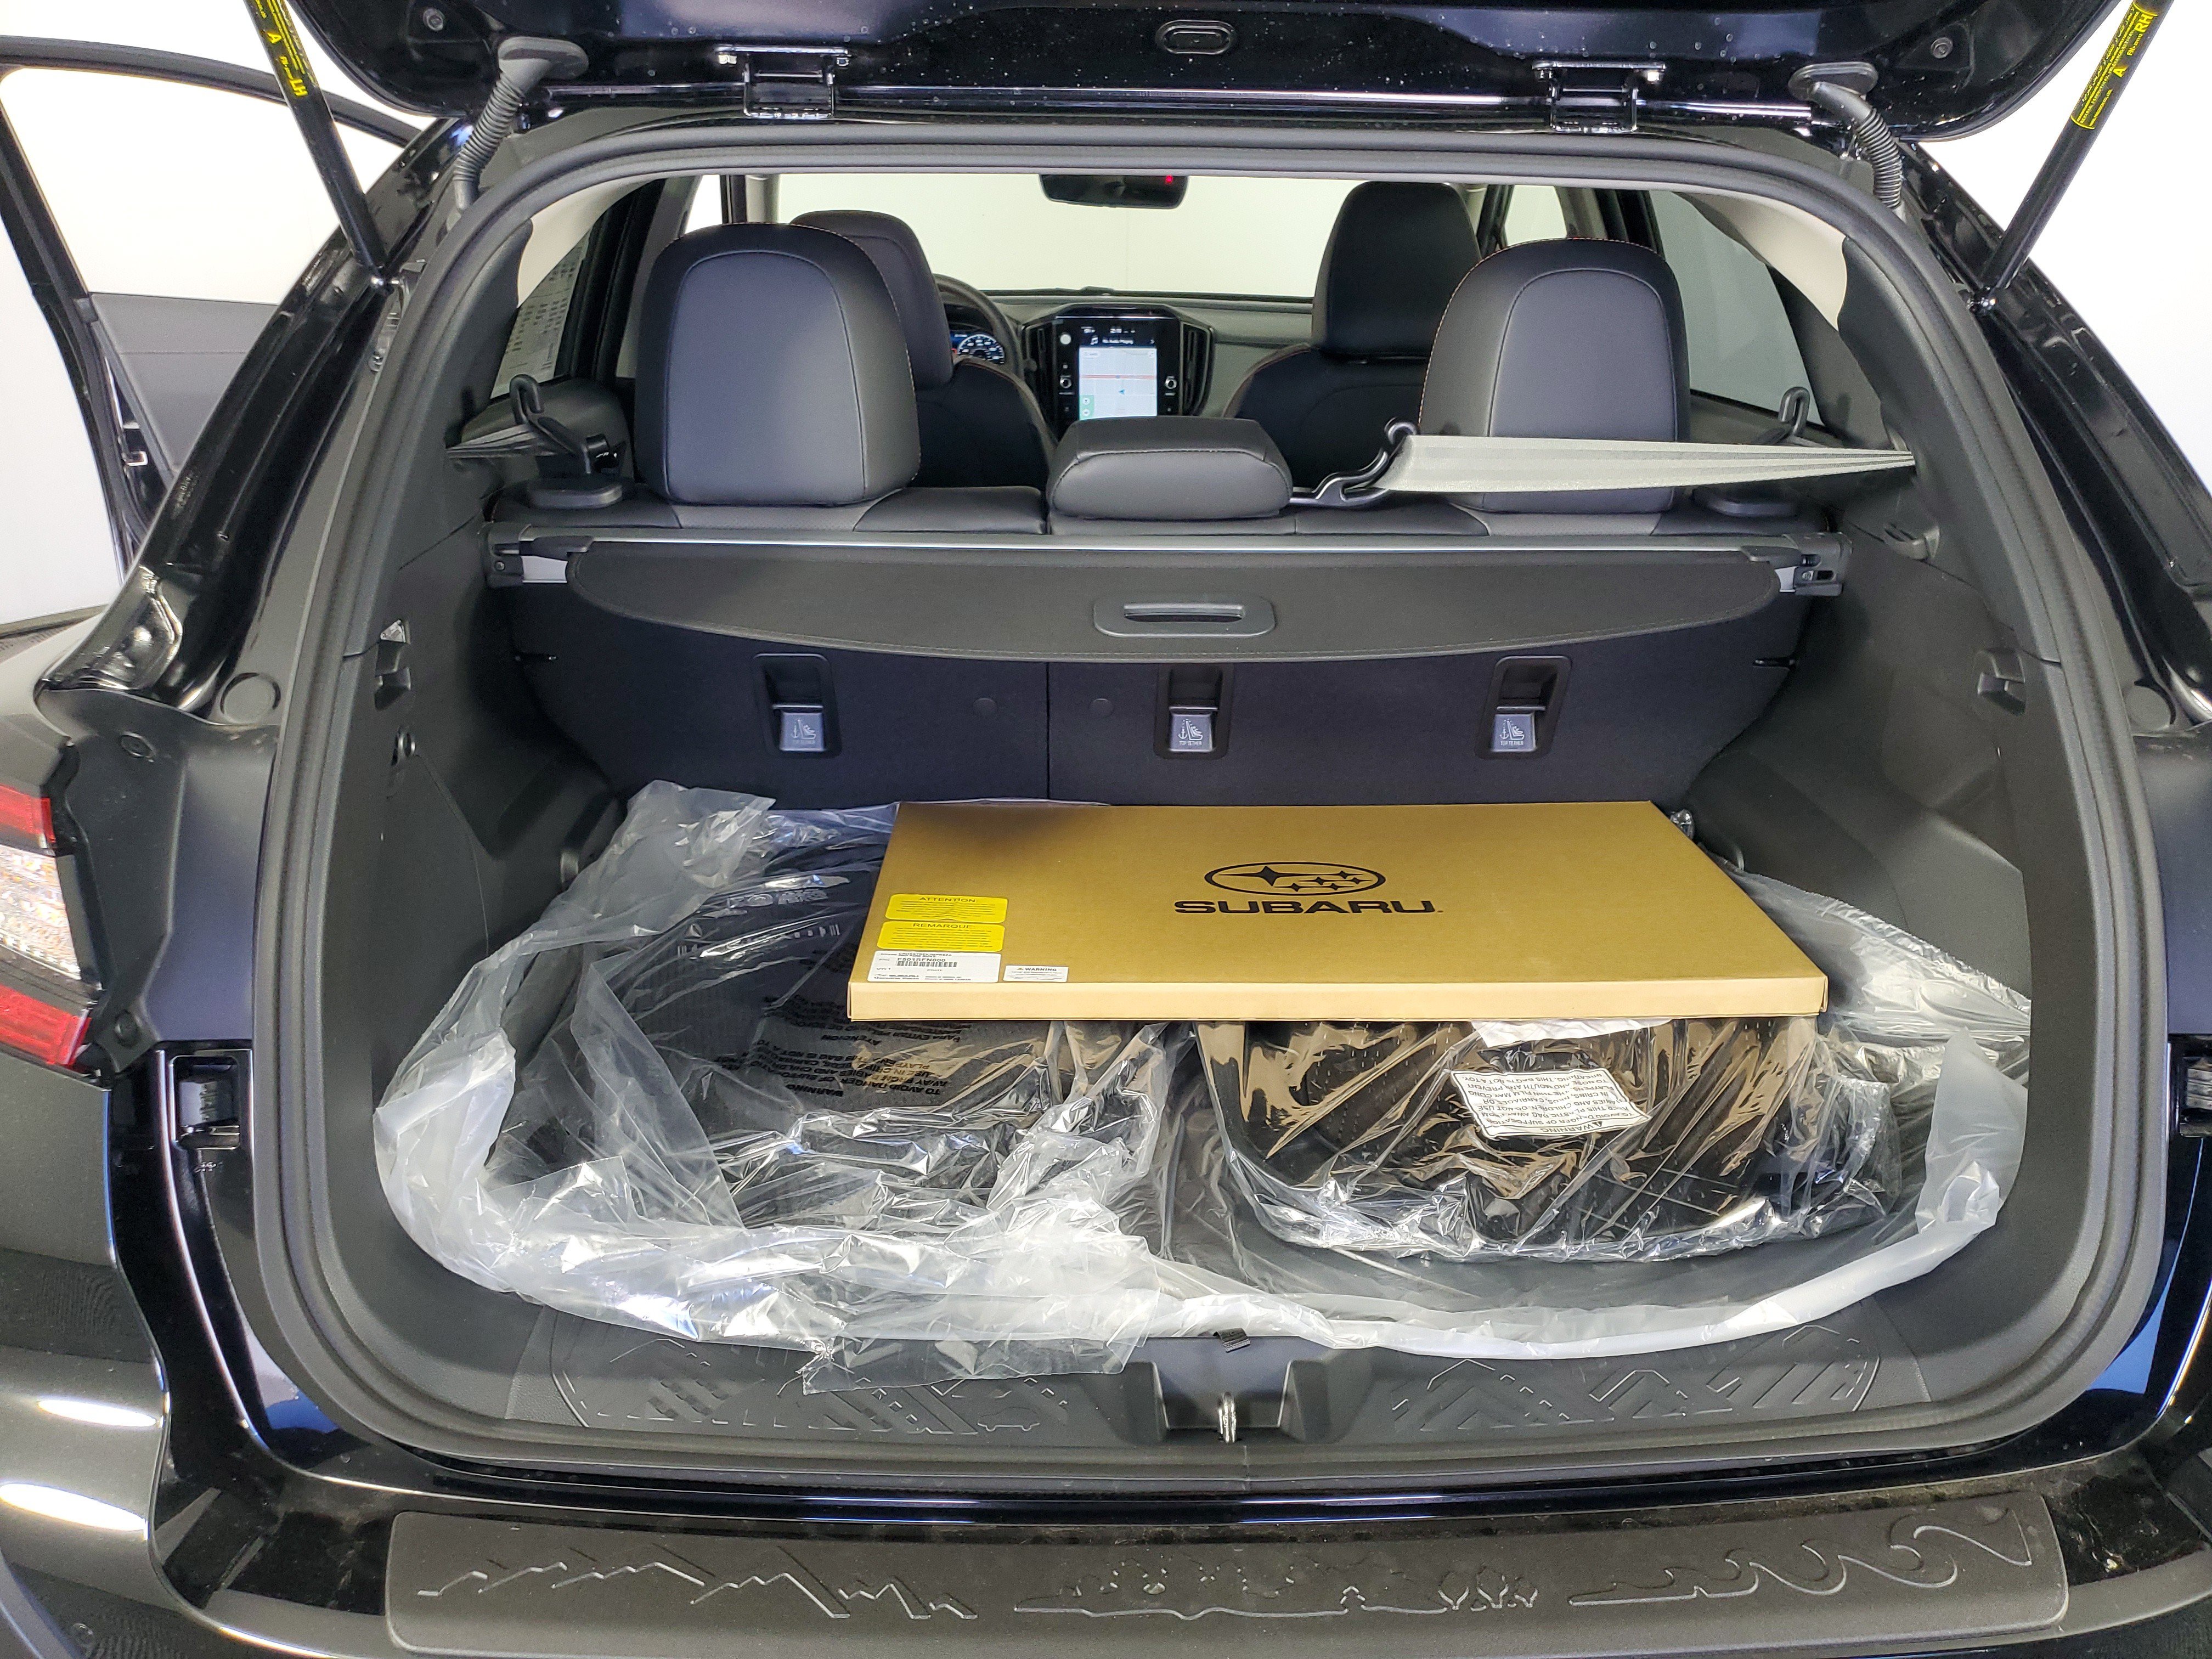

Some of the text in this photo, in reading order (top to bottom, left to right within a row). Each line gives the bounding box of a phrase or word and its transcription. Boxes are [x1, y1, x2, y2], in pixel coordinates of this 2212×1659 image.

[2134, 14, 2154, 33] RH
[289, 78, 309, 97] LH
[1174, 900, 1436, 914] SUBARU
[785, 1084, 844, 1097] WARNING
[1550, 1109, 1585, 1118] PLASTIC
[1540, 1123, 1594, 1133] WARNING
